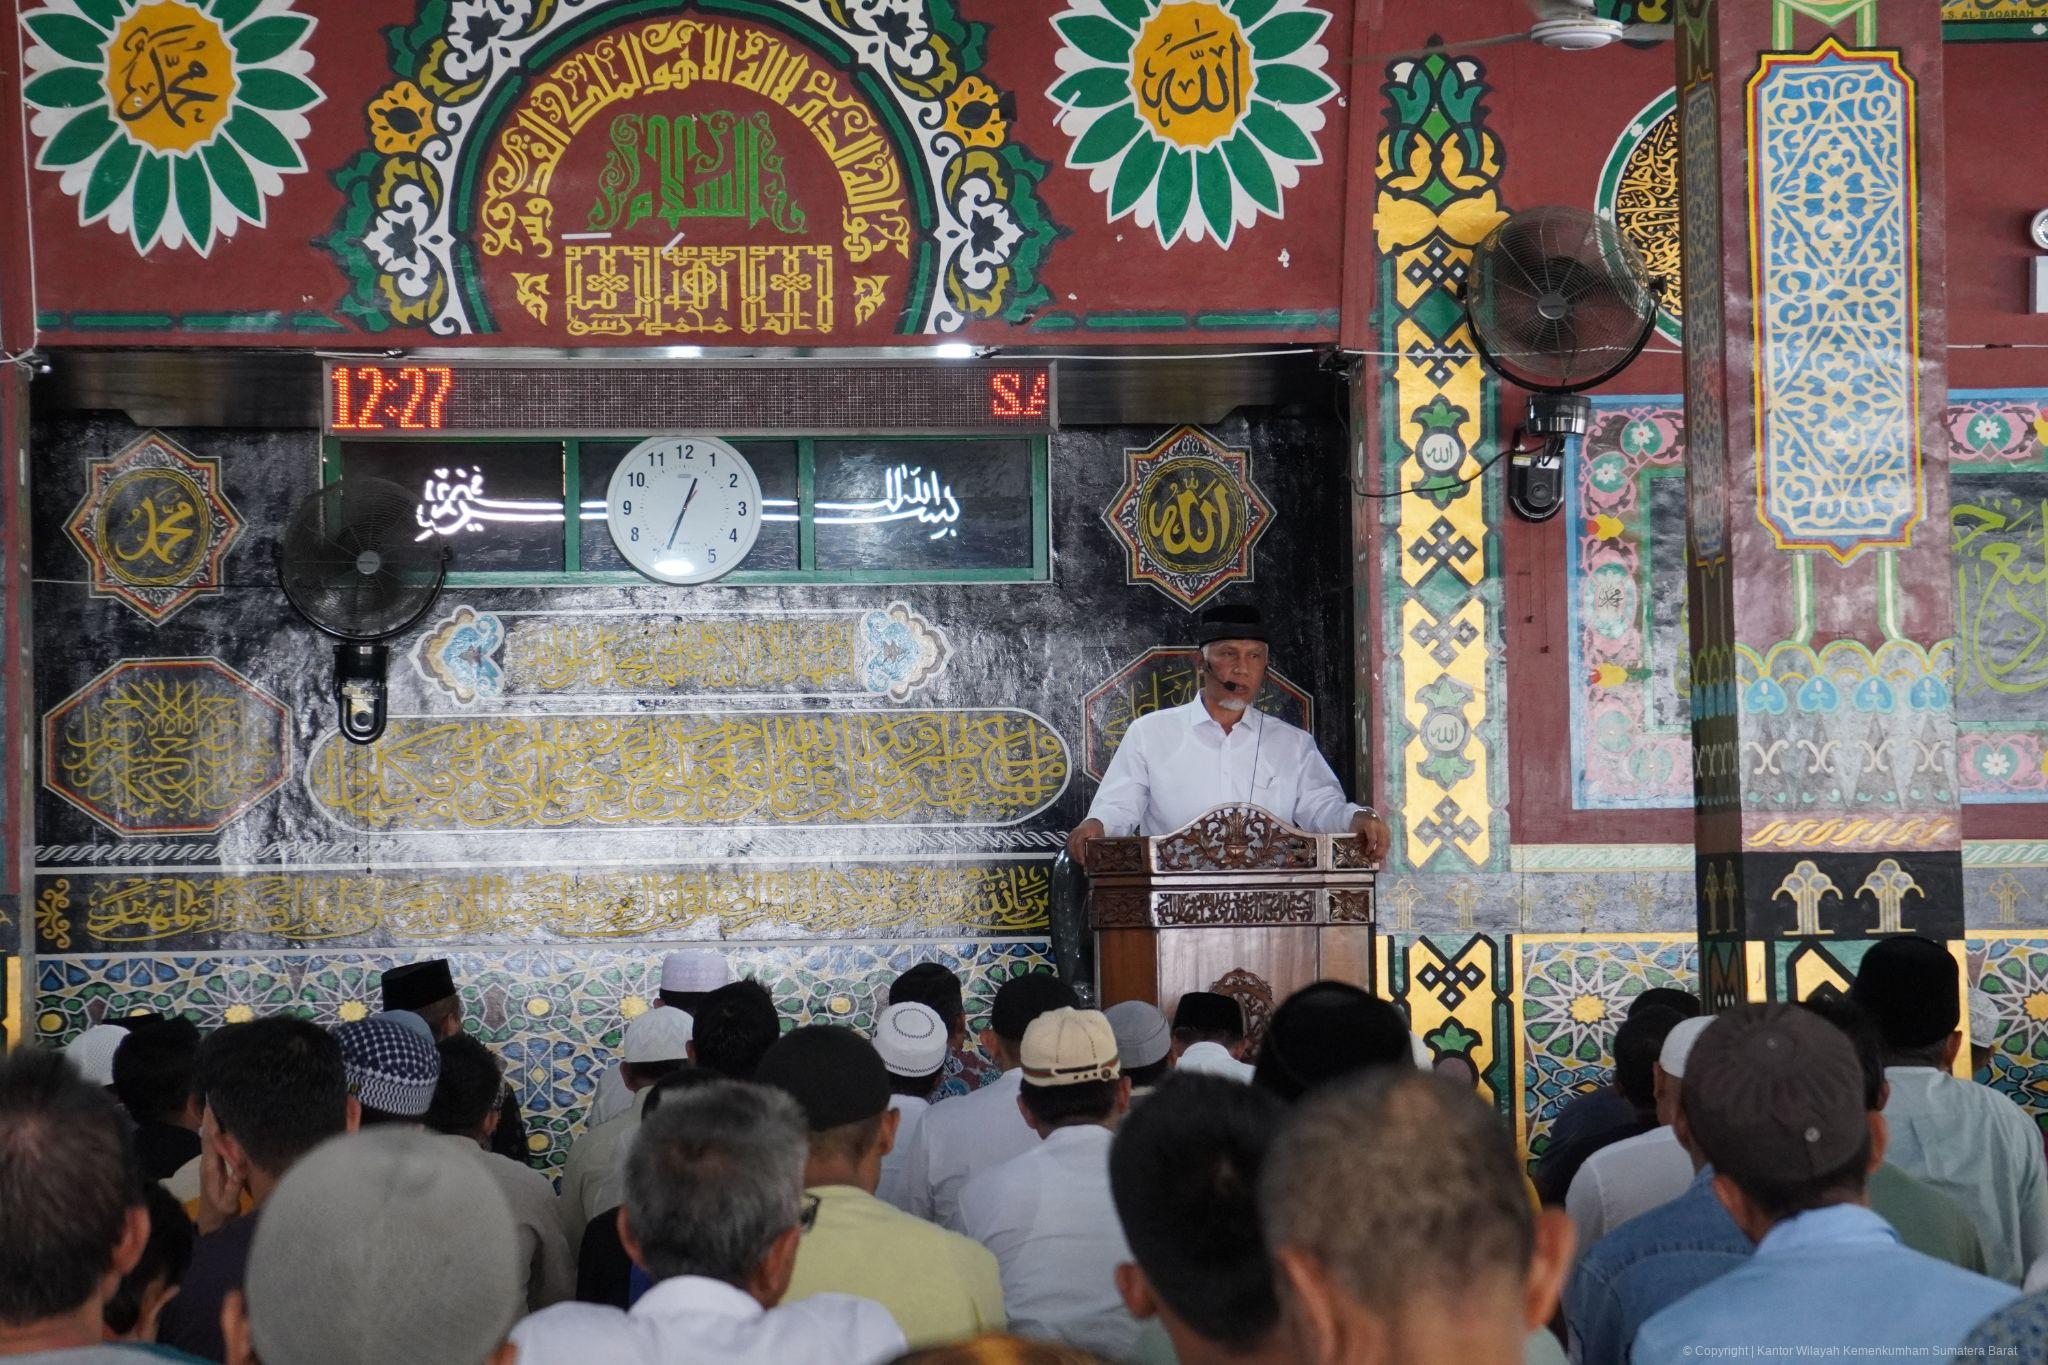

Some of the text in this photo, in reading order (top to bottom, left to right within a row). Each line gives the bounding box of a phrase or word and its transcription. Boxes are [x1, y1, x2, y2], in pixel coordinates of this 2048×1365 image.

[331, 367, 453, 429] 12:27
[648, 452, 664, 466] 11
[676, 444, 694, 459] 12
[709, 453, 715, 467] 1
[627, 472, 645, 487] 10
[729, 473, 738, 488] 2
[623, 500, 632, 515] 9
[738, 501, 747, 516] 3
[631, 527, 639, 542] 8
[729, 528, 738, 542] 4
[708, 549, 717, 563] 5
